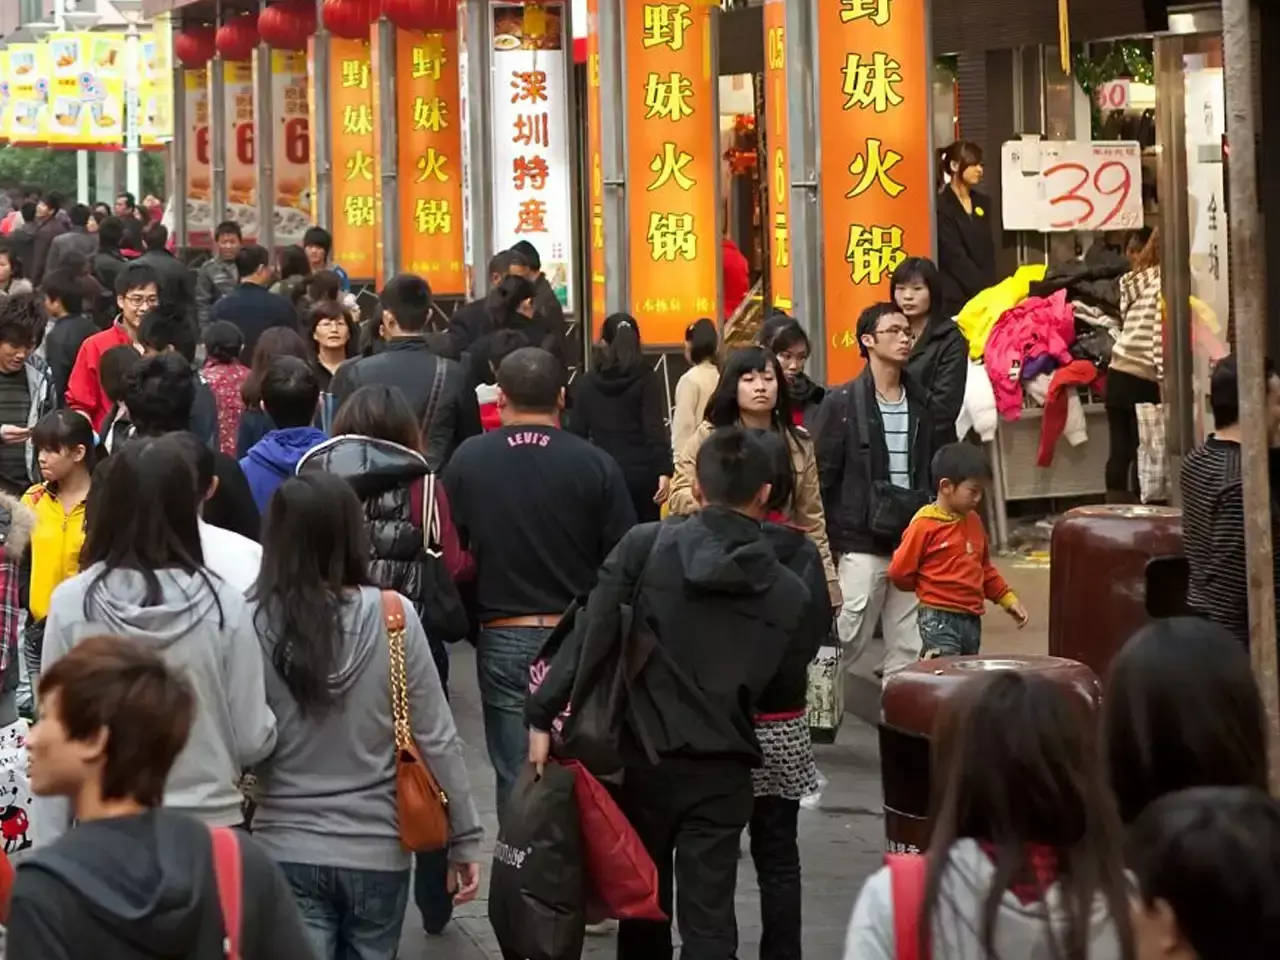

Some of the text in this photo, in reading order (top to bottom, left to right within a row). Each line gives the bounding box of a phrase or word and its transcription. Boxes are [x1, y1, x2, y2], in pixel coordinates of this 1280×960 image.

[641, 3, 698, 262] 野妹火锅
[1043, 160, 1131, 229] 39
[507, 431, 551, 447] LEVI'S
